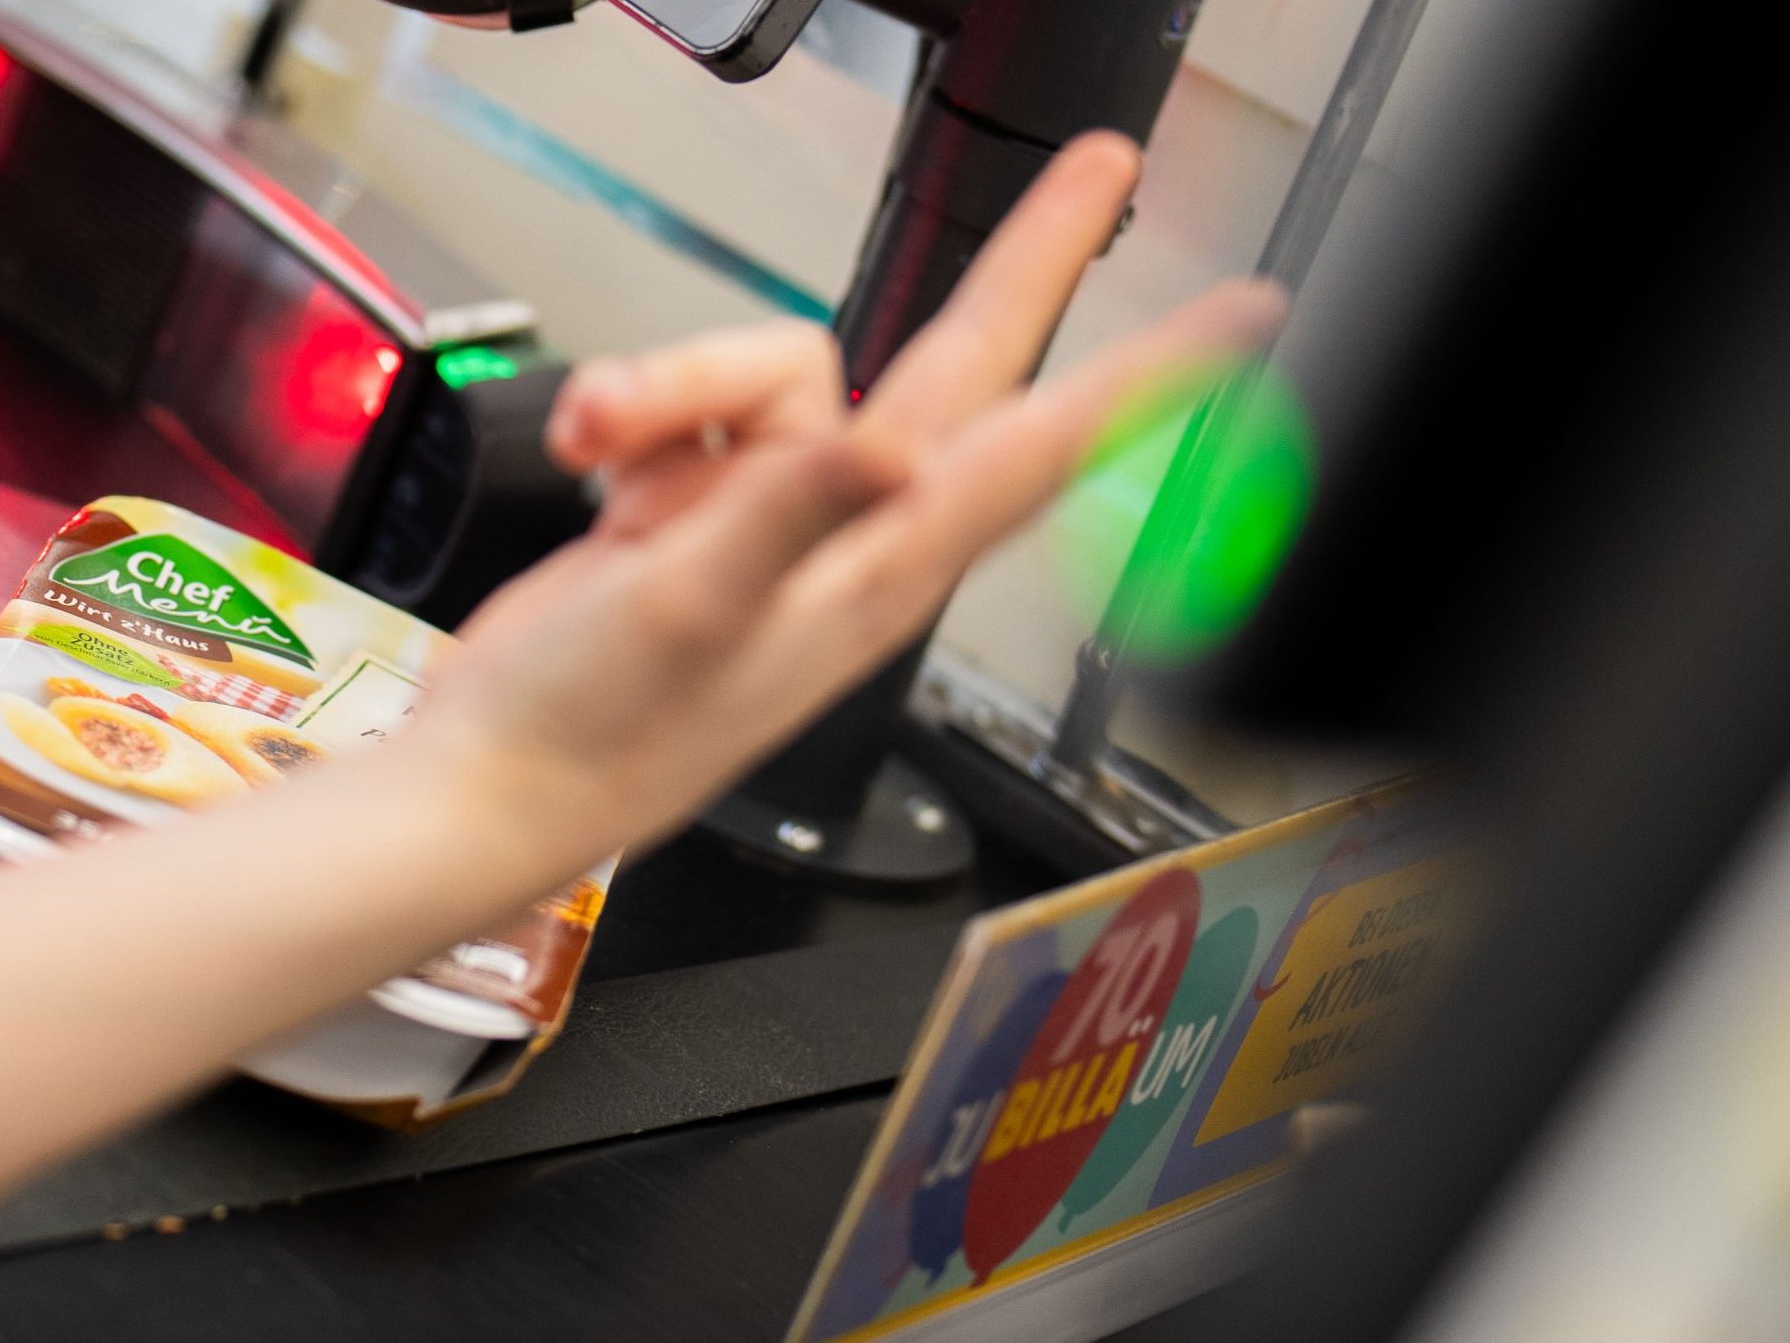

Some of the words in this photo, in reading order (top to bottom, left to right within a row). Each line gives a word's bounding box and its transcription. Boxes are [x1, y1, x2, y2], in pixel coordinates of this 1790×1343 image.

[62, 569, 292, 645] Menü
[126, 550, 235, 612] Chef
[43, 589, 112, 623] Wirt
[121, 618, 209, 652] z'Haus
[69, 637, 135, 666] Zusatz
[78, 631, 129, 657] Ohne
